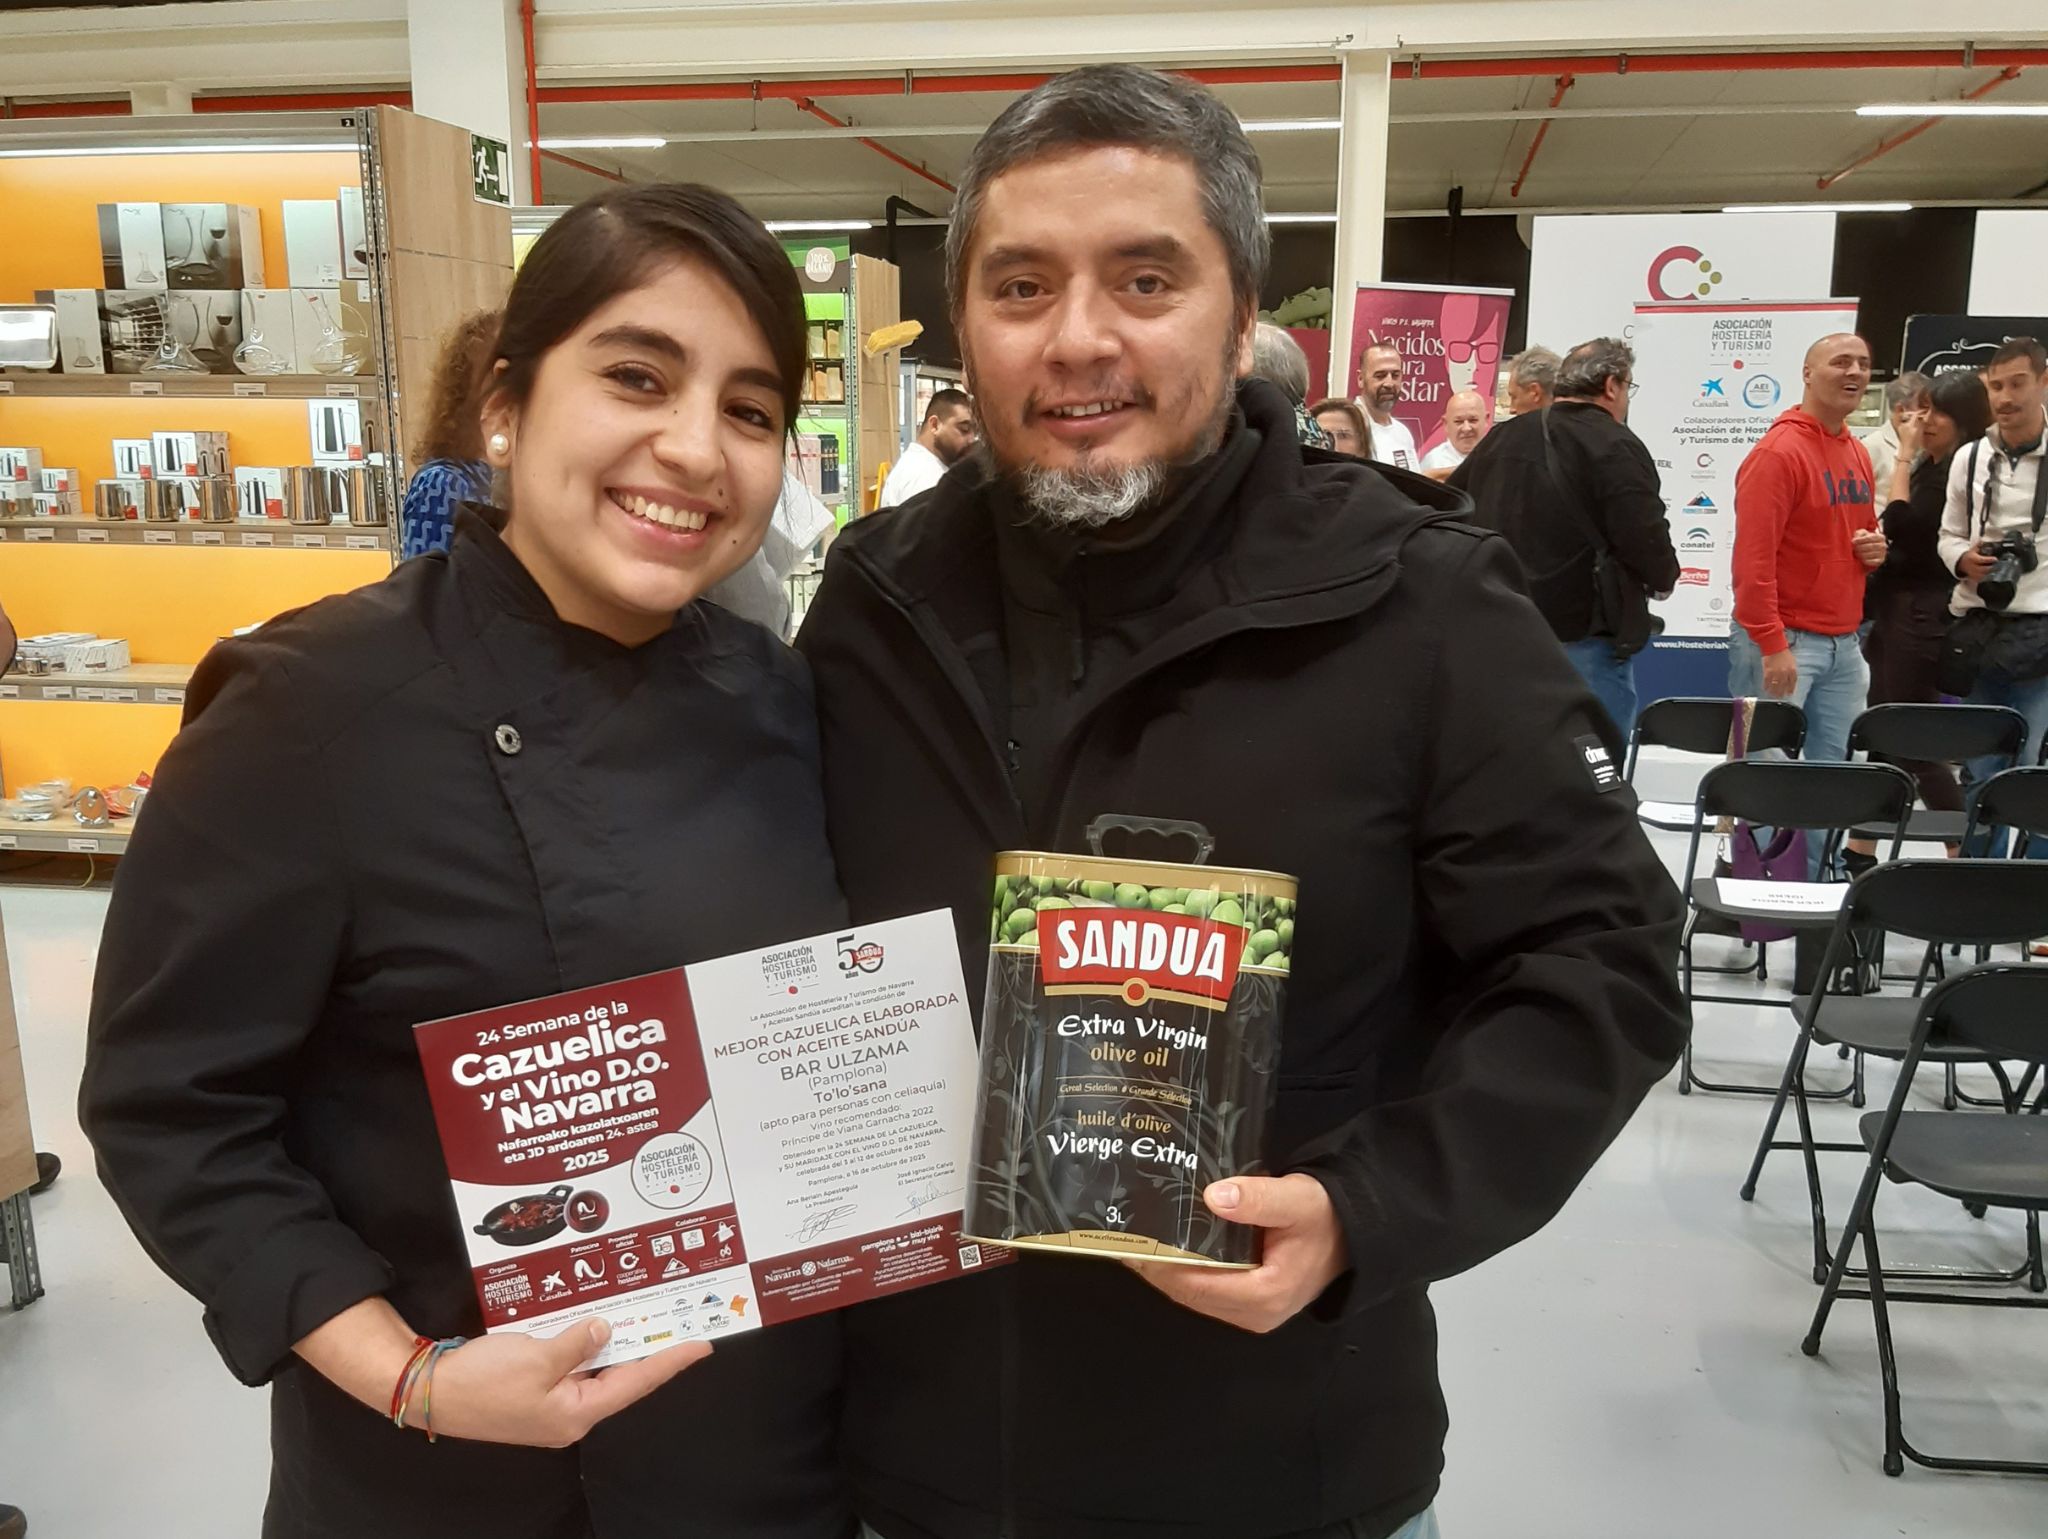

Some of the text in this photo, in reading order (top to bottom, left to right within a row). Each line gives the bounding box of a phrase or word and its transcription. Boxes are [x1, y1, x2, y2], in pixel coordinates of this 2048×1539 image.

[1712, 329, 1772, 340] HOSTELERÍA
[1713, 318, 1772, 329] ASOCIACIÓN
[1712, 341, 1771, 350] Y TURISMO
[1399, 377, 1444, 402] star
[1693, 400, 1729, 408] CaixaBank
[1673, 426, 1727, 434] Asociación
[1680, 437, 1685, 445] y
[1690, 436, 1732, 444] Turismo
[1734, 436, 1744, 444] de
[761, 945, 812, 964] ASOCIACIÓN
[836, 934, 884, 973] 50
[1057, 919, 1226, 982] SANDUA
[762, 955, 815, 974] HOSTELERÍA
[764, 975, 770, 983] Y
[774, 963, 817, 982] TURISMO
[760, 1006, 797, 1021] Asociación
[808, 995, 843, 1010] Hostelería
[849, 988, 877, 1000] Turismo
[878, 985, 887, 993] de
[888, 980, 915, 991] Navarra
[769, 1015, 794, 1027] Aceites
[795, 1009, 820, 1020] Sandúa
[822, 1002, 854, 1015] acreditan
[862, 993, 895, 1006] condición
[476, 1001, 628, 1046] 24 Semana de la
[713, 993, 959, 1058] MEJOR CAZUELICA ELABORADA
[1057, 1014, 1208, 1051] Extra Virgin
[451, 1019, 667, 1086] Cazuelica
[757, 1018, 920, 1065] CON ACEITE SANDÚA
[781, 1039, 909, 1081] BAR ULZAMA
[1090, 1041, 1168, 1068] olive oil
[480, 1051, 669, 1110] y el Vino D.O.
[808, 1061, 888, 1090] (Pamplona)
[813, 1077, 888, 1104] To'lo'sana
[1060, 1083, 1081, 1092] Great
[1084, 1083, 1118, 1092] Selection
[1129, 1086, 1158, 1096] Grande
[500, 1079, 657, 1134] Navarra
[759, 1079, 946, 1132] (apto para personas con celiaquía)
[810, 1104, 902, 1131] Vino recomendado:
[497, 1107, 659, 1152] Nafarroako kazolatxoaren
[781, 1105, 934, 1148] Príncipe de Viana Garnacha 2022
[1077, 1108, 1172, 1134] huile d'olive
[504, 1120, 659, 1164] eta JD ardoaren 24. astea
[783, 1148, 815, 1161] Obtenido
[844, 1133, 875, 1146] SEMANA
[877, 1131, 886, 1139] DE
[888, 1128, 898, 1136] LA
[899, 1119, 938, 1133] CAZUELICA
[784, 1135, 908, 1170] SU MARIDAJE CON VINO DE
[1046, 1132, 1199, 1170] Vierge Extra
[563, 1148, 609, 1172] 2025
[641, 1142, 695, 1164] ASOCIACIÓN
[642, 1152, 698, 1173] HOSTELERÍA
[796, 1139, 930, 1177] celebrada del octubre de 2025
[644, 1174, 649, 1182] Y
[654, 1162, 700, 1180] TURISMO
[808, 1174, 845, 1187] Pamplona,
[861, 1167, 869, 1176] de
[871, 1161, 898, 1172] octubre
[909, 1153, 926, 1162] 2025
[897, 1161, 954, 1179] José Ignacio Calvo
[905, 1168, 955, 1184] Secretario General
[786, 1198, 799, 1206] Ana
[675, 1214, 707, 1228] Colaboran
[1105, 1206, 1125, 1224] 3L
[570, 1242, 600, 1255] Patrocina
[861, 1238, 895, 1253] pamplona
[489, 1263, 517, 1275] Organiza
[764, 1268, 801, 1284] Navarra
[484, 1274, 529, 1292] ASOCIACIÓN
[484, 1282, 531, 1299] HOSTELERÍA
[487, 1297, 494, 1307] Y
[497, 1289, 533, 1305] TURISMO
[528, 1312, 570, 1328] Colaboradores
[569, 1306, 594, 1318] Oficiales
[594, 1299, 625, 1312] Asociación
[665, 1285, 686, 1295] Turismo
[696, 1277, 717, 1287] Navarra
